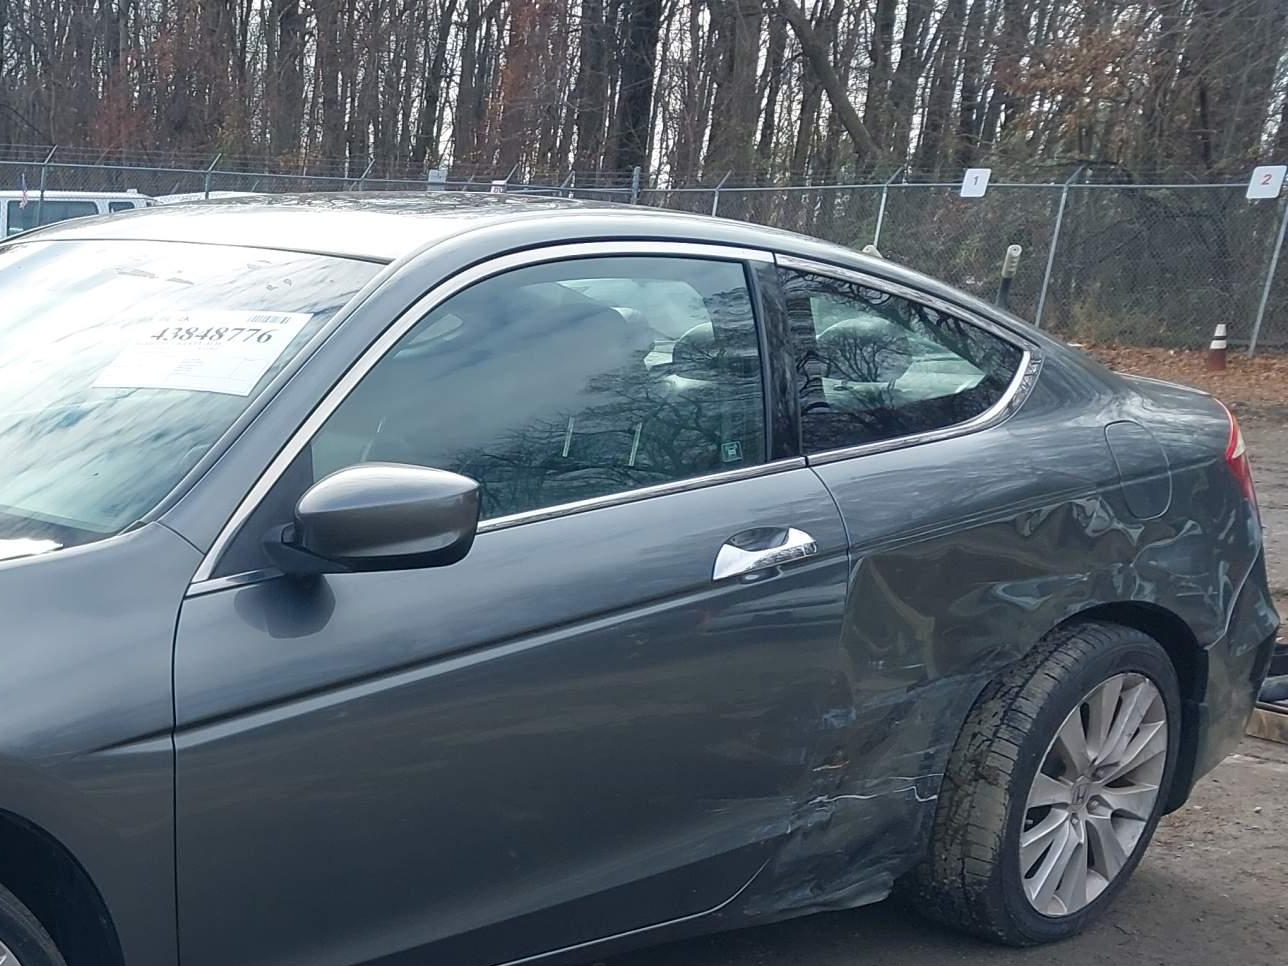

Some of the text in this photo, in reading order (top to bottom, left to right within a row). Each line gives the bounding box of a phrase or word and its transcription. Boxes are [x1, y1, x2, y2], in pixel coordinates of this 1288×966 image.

[973, 175, 979, 186] 1
[1261, 174, 1272, 186] 2
[150, 327, 279, 343] 43848776
